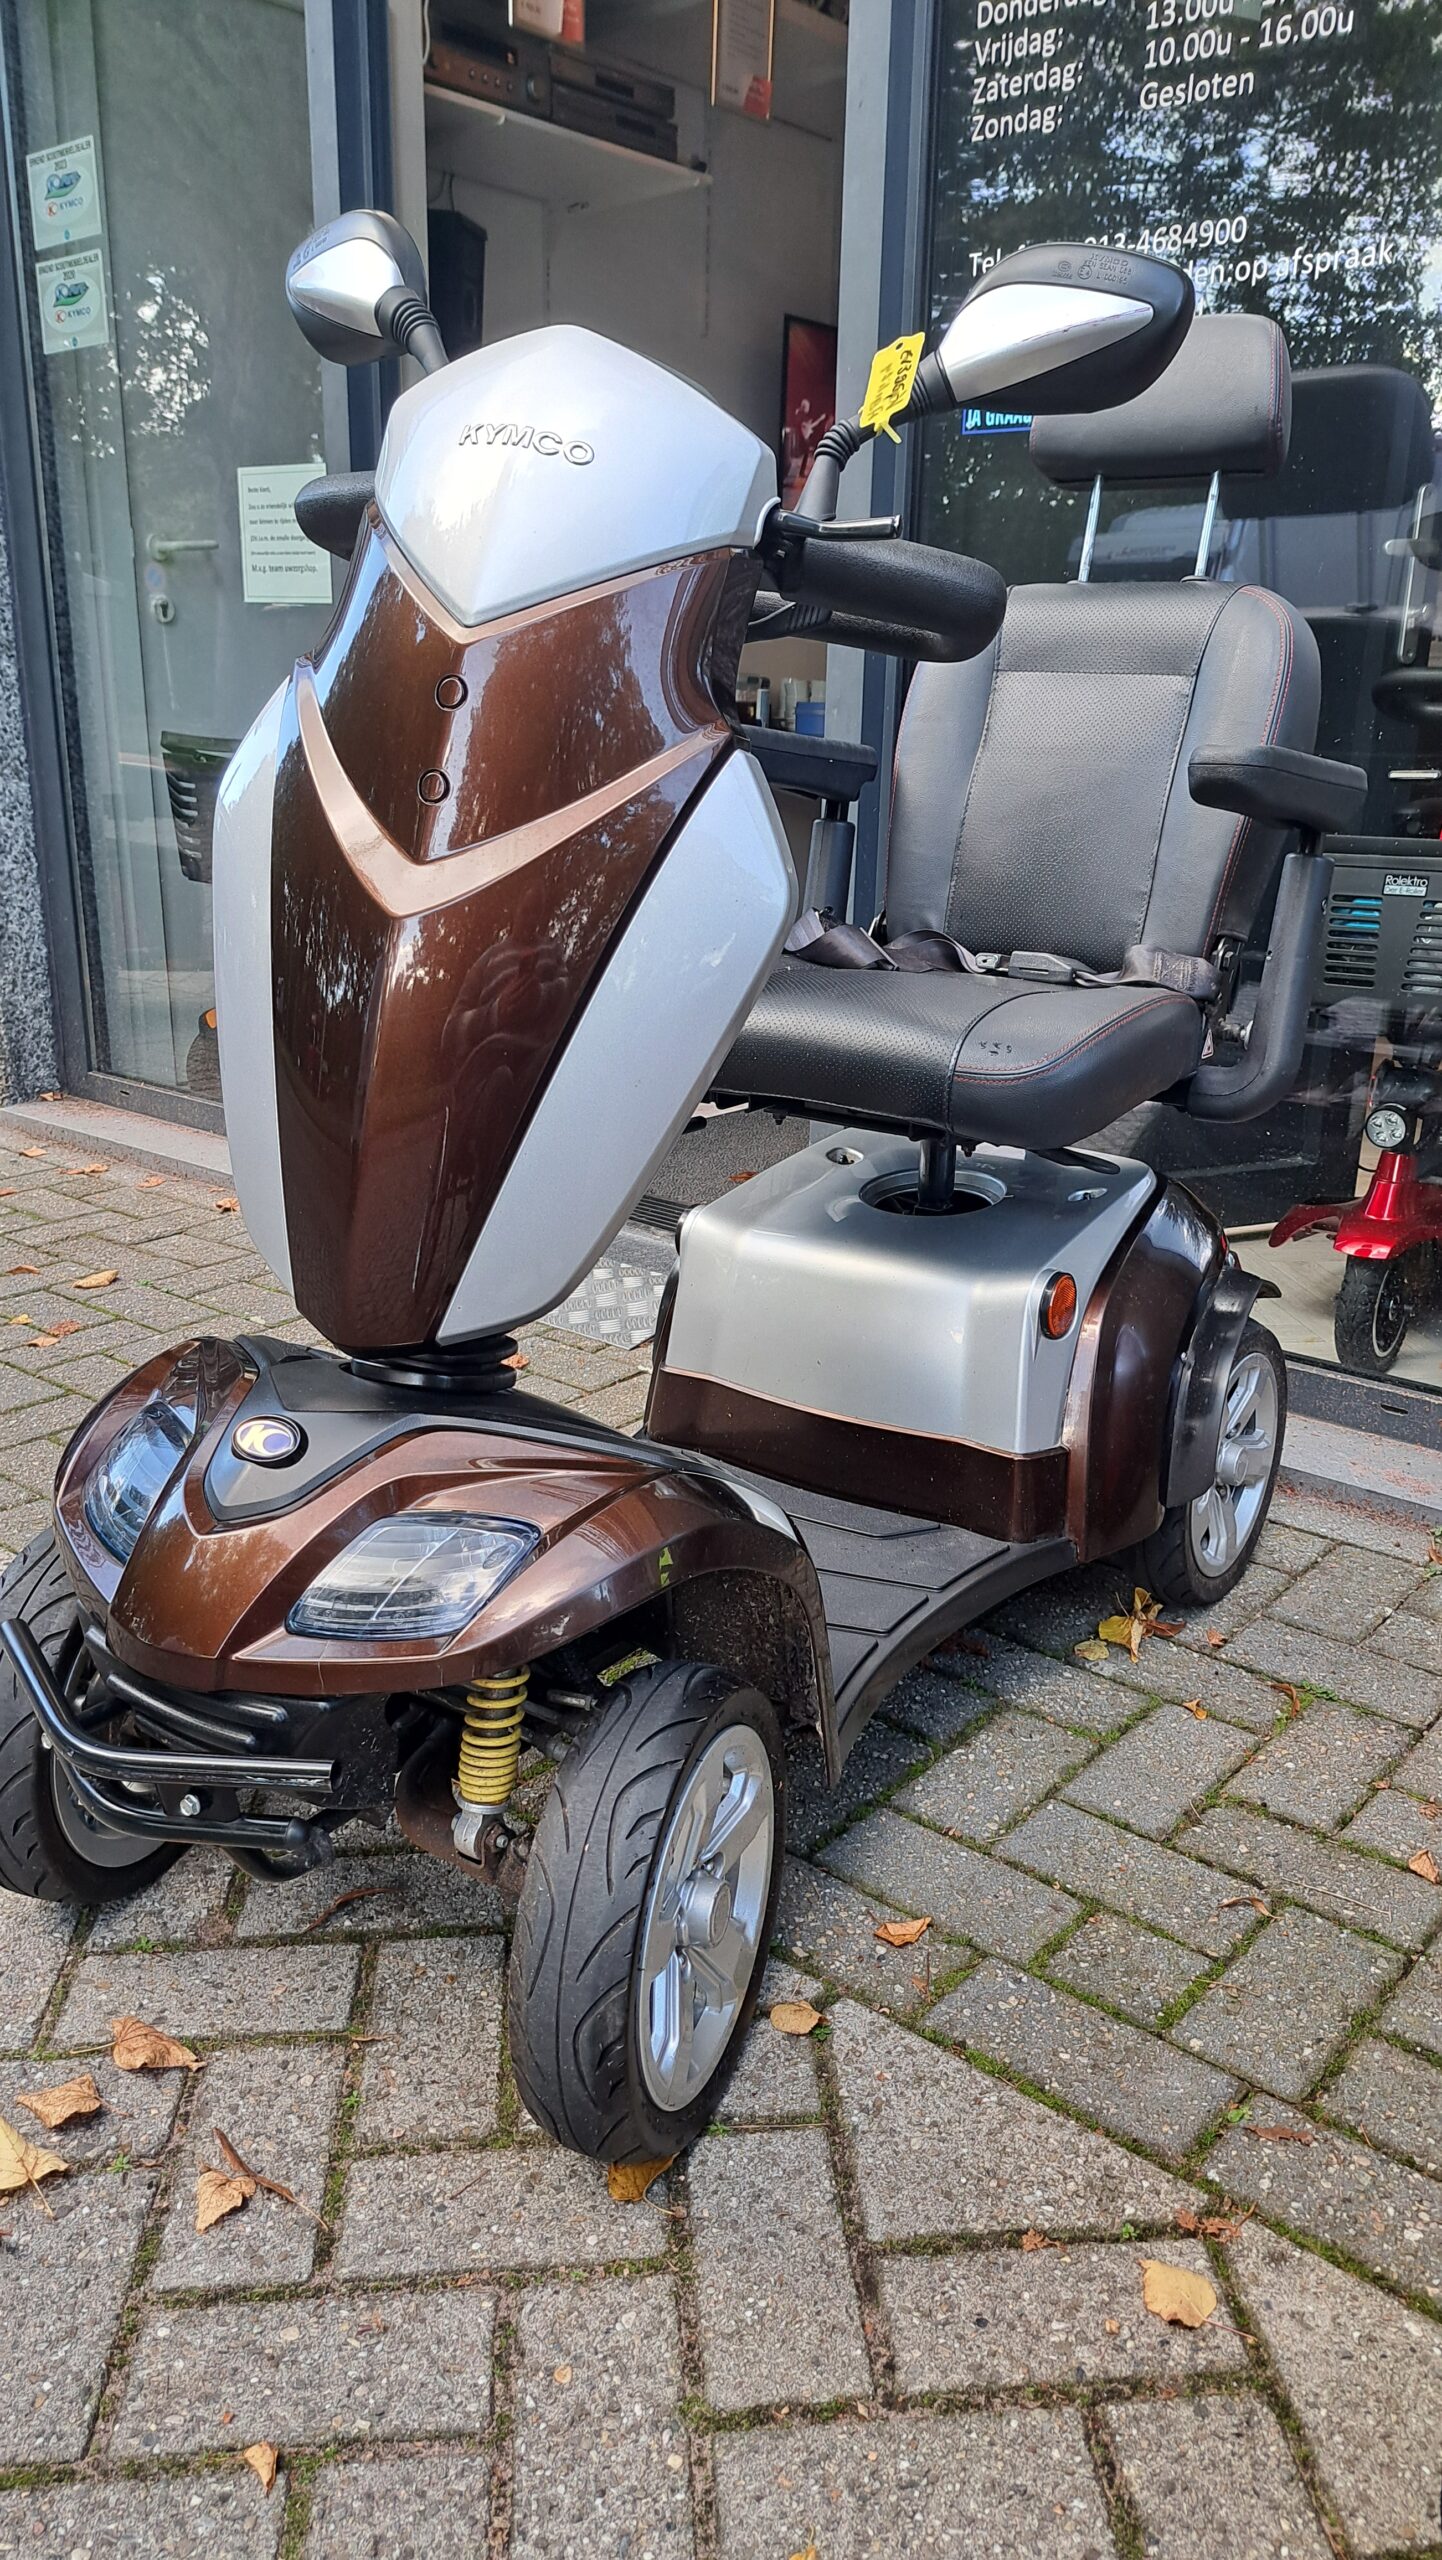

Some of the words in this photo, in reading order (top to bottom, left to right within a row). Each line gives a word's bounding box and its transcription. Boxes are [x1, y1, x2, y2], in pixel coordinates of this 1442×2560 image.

[972, 59, 1083, 105] Zaterdag:
[1144, 29, 1232, 70] 10.00u
[1259, 7, 1354, 48] 16.00u
[975, 27, 1064, 67] Vrijdag:
[971, 102, 1064, 142] Zondag:
[1140, 71, 1255, 109] Gesloten
[1276, 236, 1396, 280] afspraak
[458, 423, 595, 466] KYMCO
[1385, 874, 1429, 887] Rolektro
